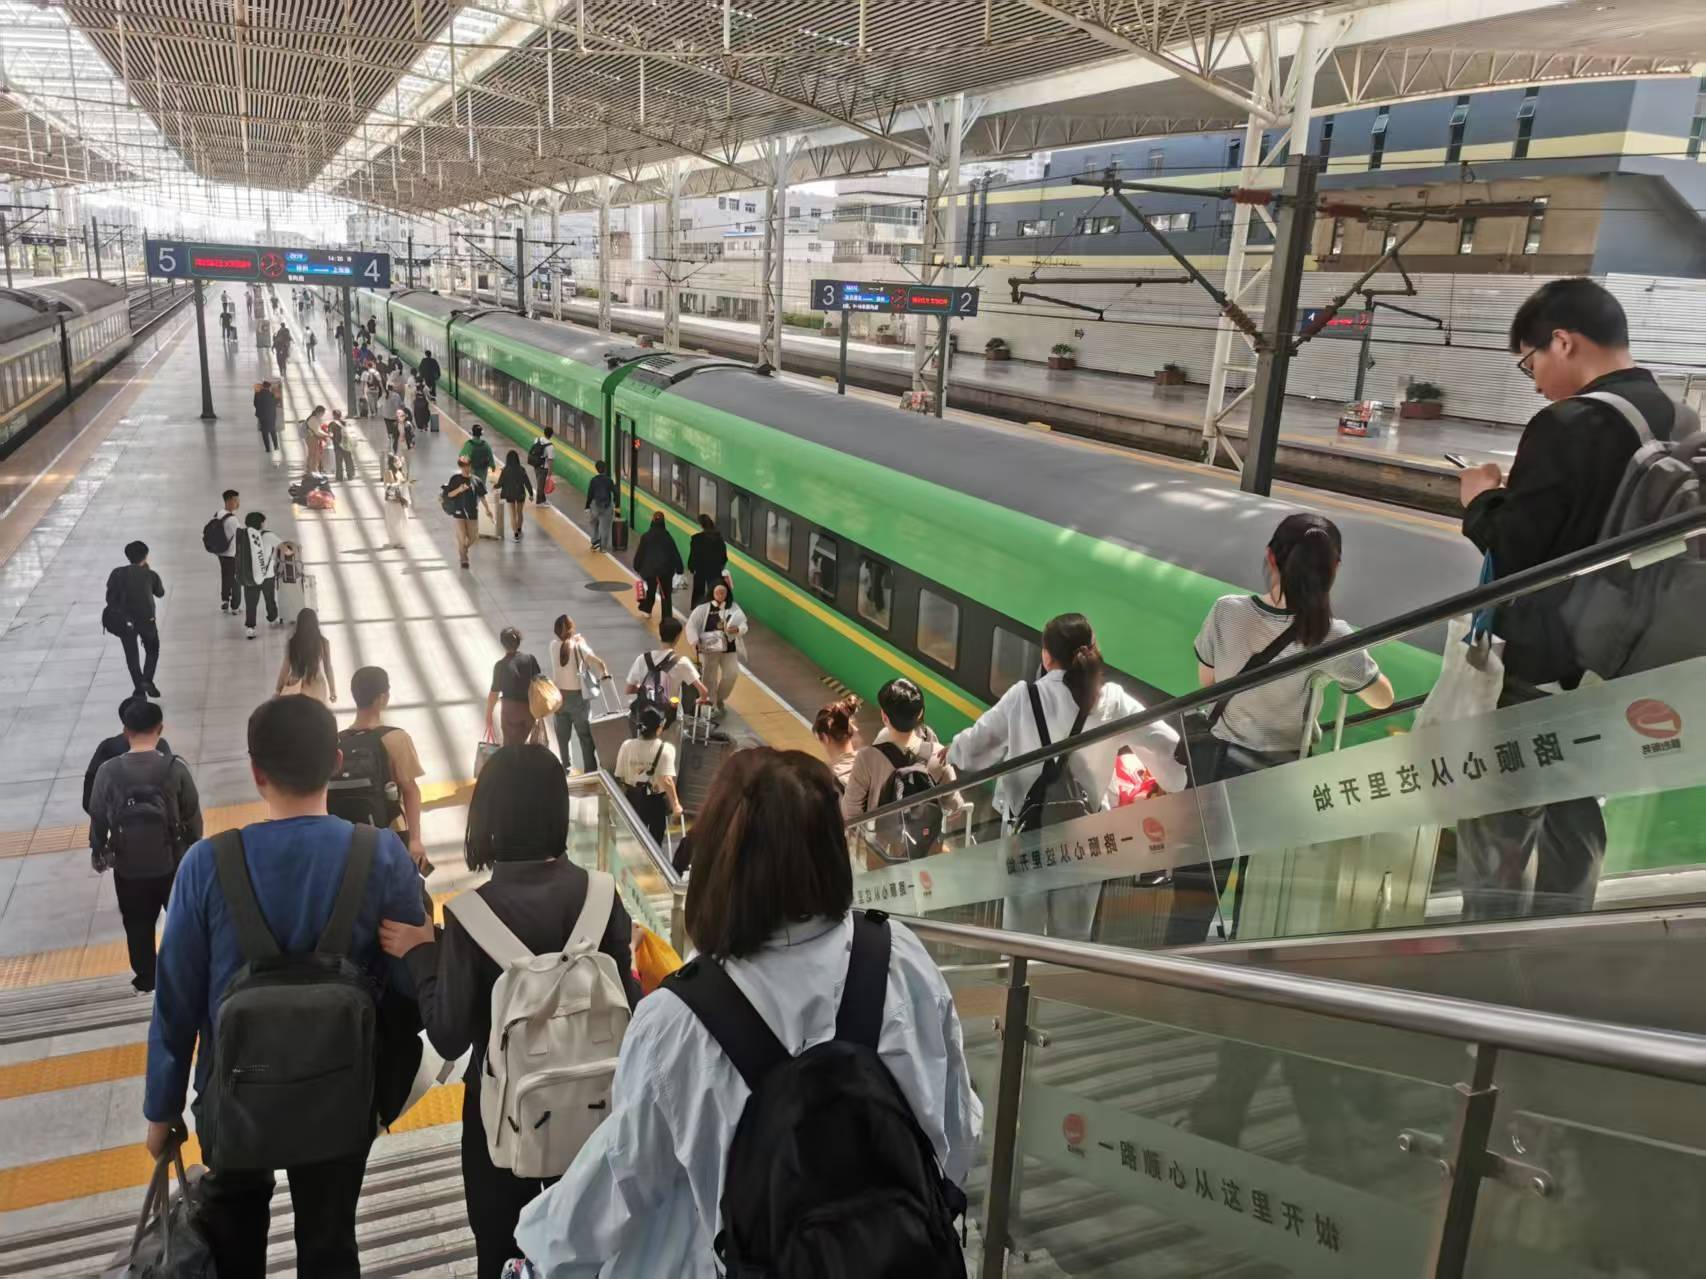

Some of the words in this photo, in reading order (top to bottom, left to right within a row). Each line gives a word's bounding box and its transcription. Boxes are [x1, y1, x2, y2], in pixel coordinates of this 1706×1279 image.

[159, 247, 177, 272] 5
[364, 259, 380, 282] 4
[823, 285, 835, 306] 3
[960, 293, 973, 312] 2
[1097, 1140, 1340, 1252] 一路顺心从这里开始
